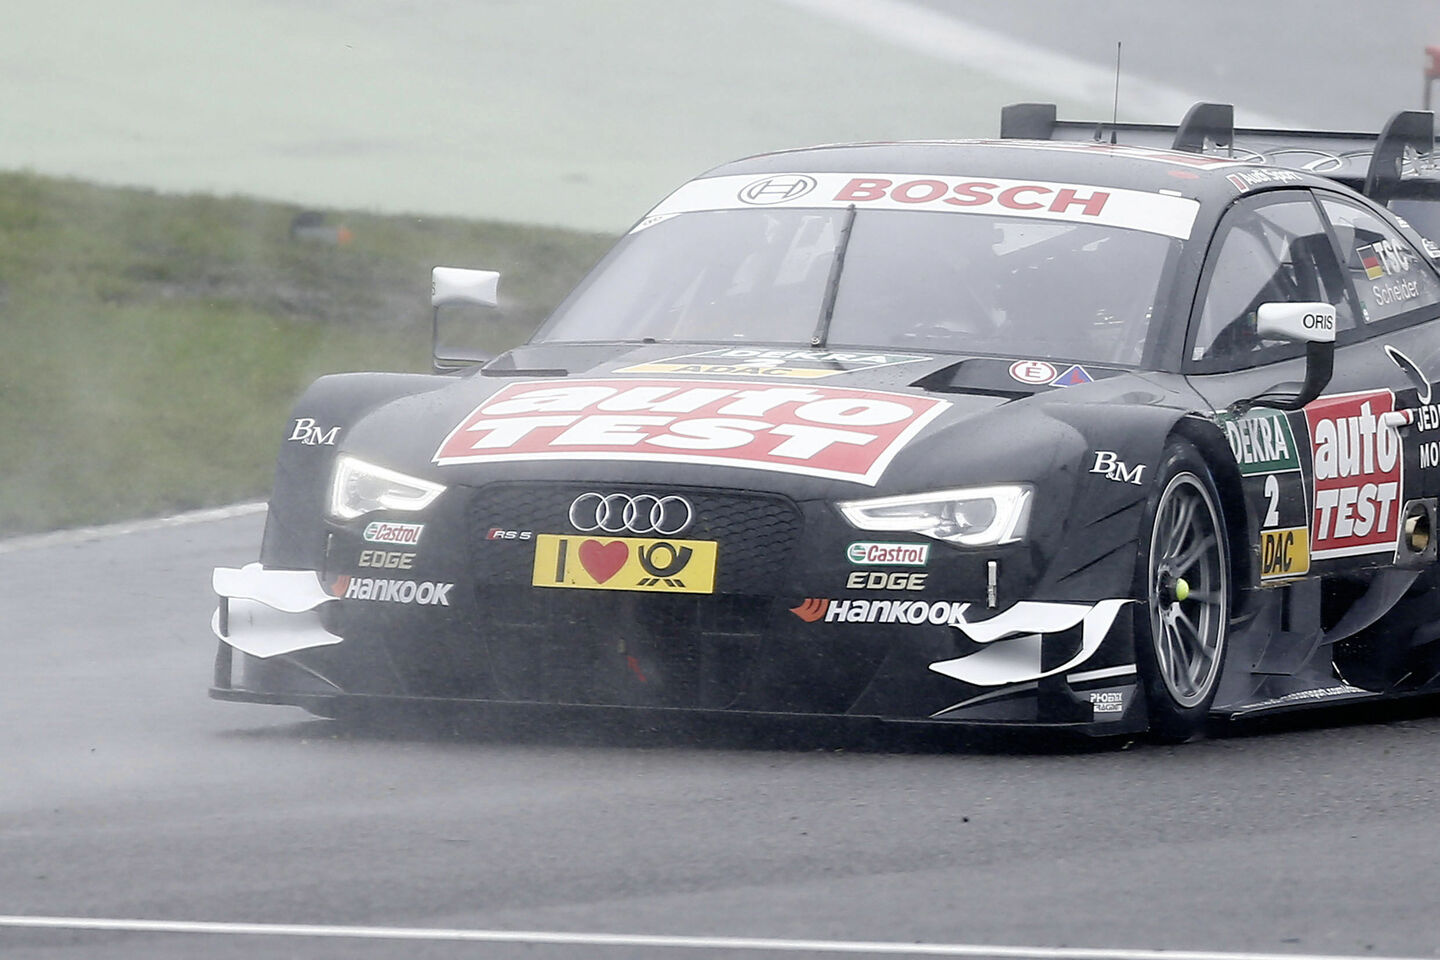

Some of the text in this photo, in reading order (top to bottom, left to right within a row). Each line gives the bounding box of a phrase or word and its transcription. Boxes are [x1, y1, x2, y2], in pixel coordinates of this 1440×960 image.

[832, 178, 1111, 216] BOSCH
[1303, 314, 1333, 329] ORIS
[721, 349, 888, 363] DEKRA
[672, 366, 793, 376] ADAC
[479, 384, 915, 427] auto
[465, 415, 878, 460] TEST
[1225, 415, 1290, 464] DEKRA
[1314, 401, 1398, 480] auto
[1263, 475, 1279, 527] 2
[1316, 482, 1398, 540] TEST
[374, 524, 421, 544] Castrol
[492, 530, 532, 540] RS 5
[358, 550, 416, 570] EDGE
[867, 545, 924, 563] Castrol
[1262, 531, 1294, 574] DAC
[846, 571, 929, 591] EDGE
